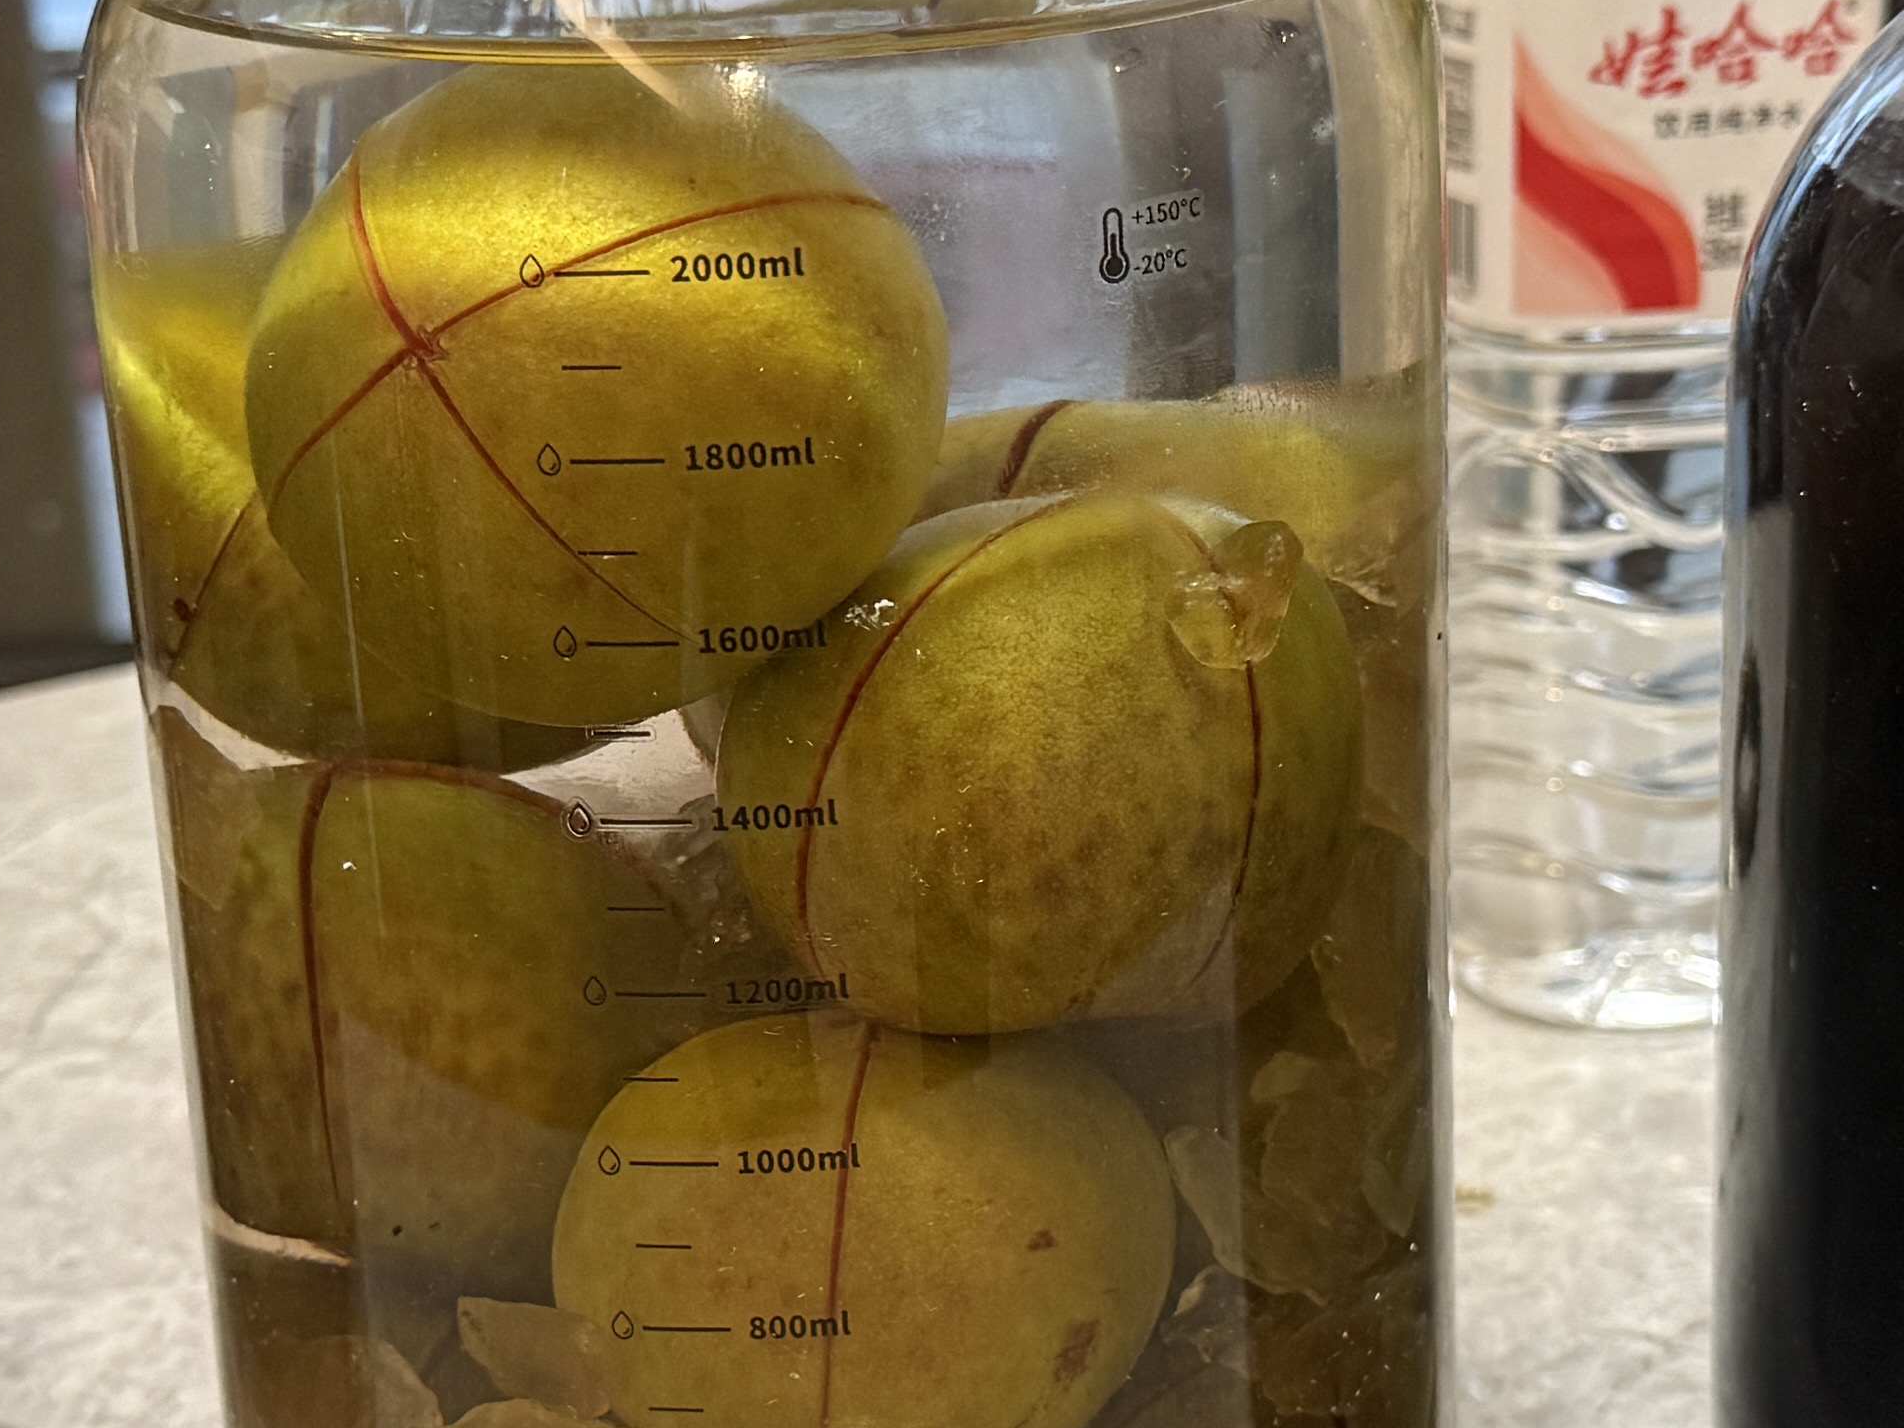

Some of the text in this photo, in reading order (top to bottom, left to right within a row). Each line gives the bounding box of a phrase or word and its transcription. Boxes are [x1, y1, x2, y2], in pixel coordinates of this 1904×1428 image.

[670, 247, 805, 283] 2000ml
[684, 437, 816, 472] 1800ml
[698, 622, 827, 655] 1600ml
[710, 798, 839, 832] 1400ml
[724, 973, 850, 1007] 1200ml
[736, 1143, 862, 1176] 1000ml
[749, 1311, 851, 1341] 800ml
